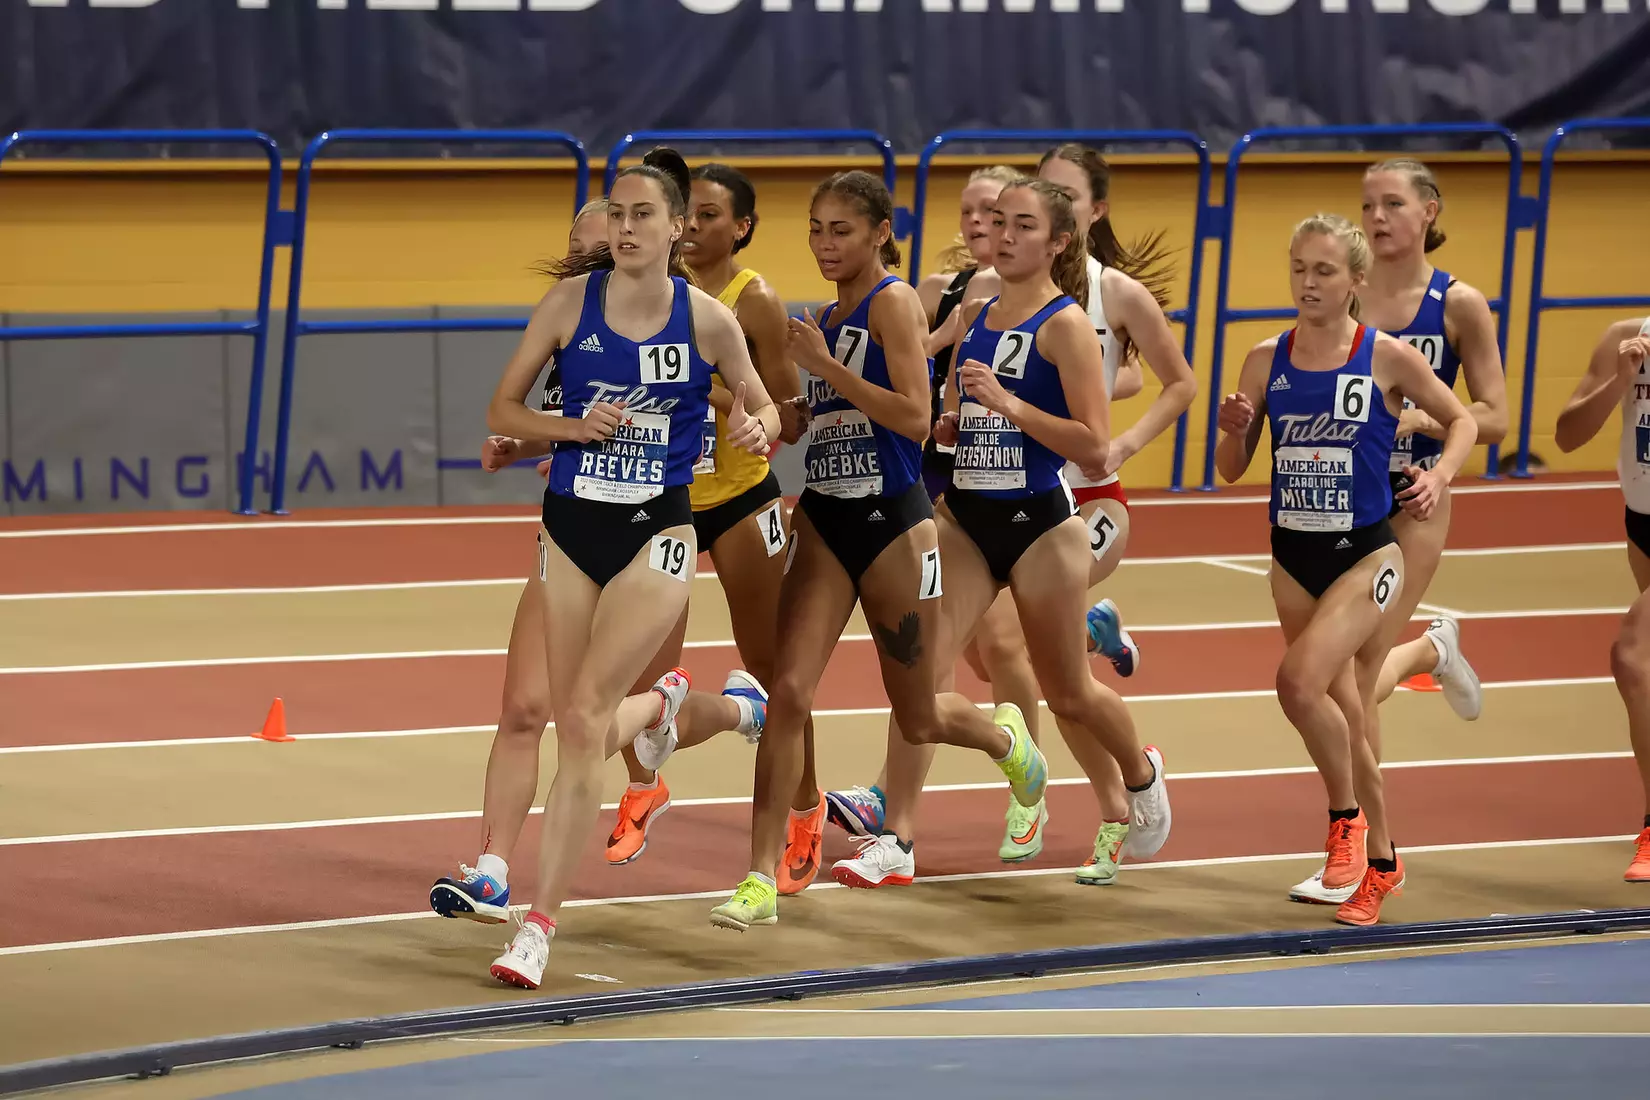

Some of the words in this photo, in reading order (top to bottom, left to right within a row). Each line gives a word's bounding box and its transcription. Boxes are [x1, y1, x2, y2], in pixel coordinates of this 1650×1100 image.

[578, 342, 604, 353] adidas
[647, 345, 681, 381] 19
[842, 328, 863, 366] 7
[997, 333, 1023, 375] 2
[1343, 377, 1364, 418] 6
[612, 425, 662, 443] RICAN
[811, 423, 868, 444] AMERICAN
[973, 433, 1000, 445] CHLOE
[1278, 412, 1360, 445] Tulsa
[601, 441, 645, 458] TAMARA
[808, 451, 879, 480] ROEBKE
[955, 446, 1023, 468] HERSHENOW
[3, 449, 404, 501] MINGHAM
[580, 452, 664, 483] REEVES
[1279, 460, 1347, 474] AMERICAN
[1289, 476, 1337, 488] CAROLINE
[1280, 488, 1349, 511] MILLER
[768, 508, 783, 547] 4
[1091, 515, 1114, 551] 5
[659, 538, 686, 576] 19
[927, 551, 937, 597] 7
[1375, 568, 1395, 605] 6
